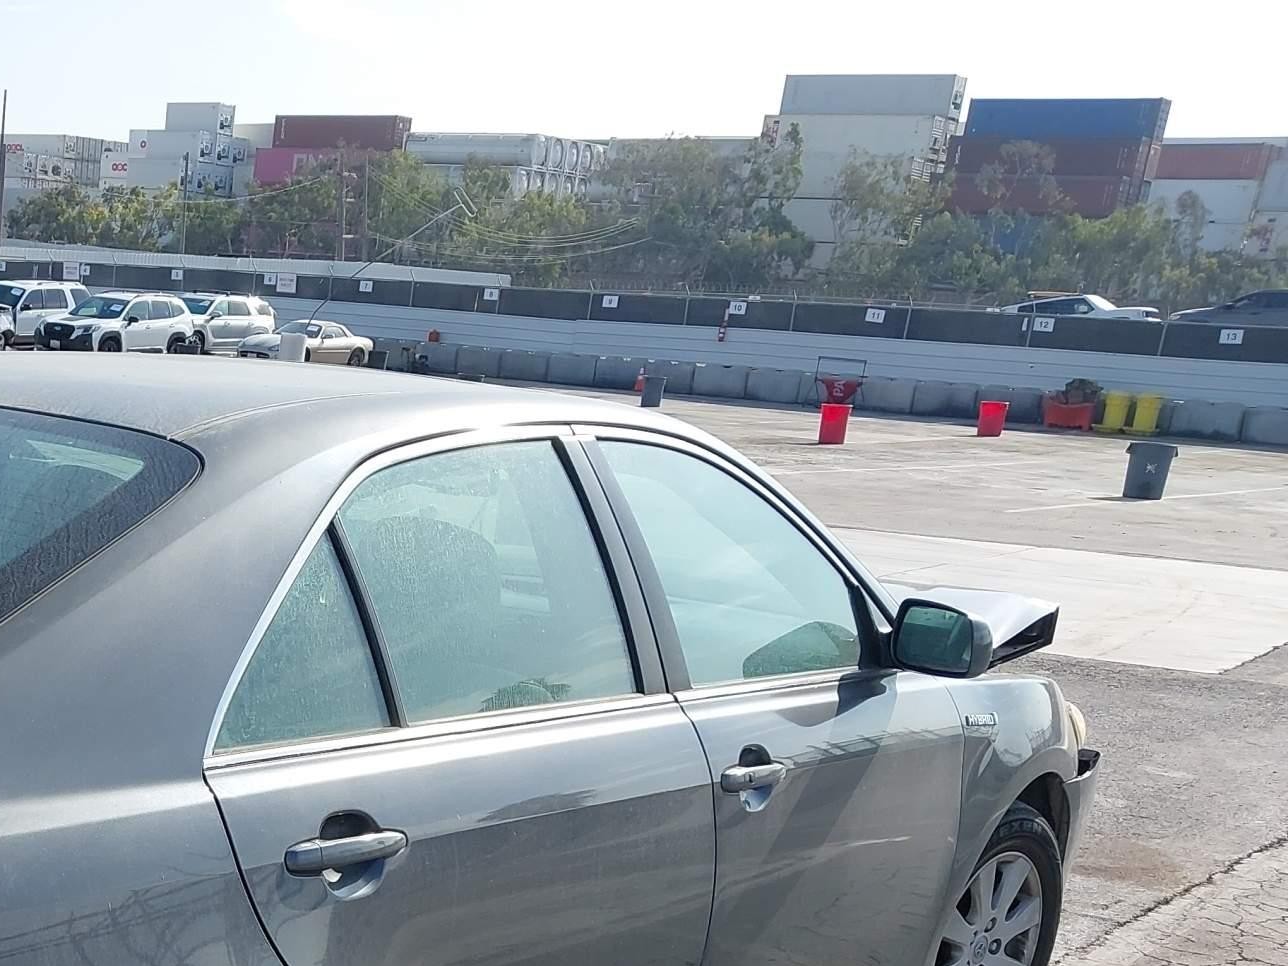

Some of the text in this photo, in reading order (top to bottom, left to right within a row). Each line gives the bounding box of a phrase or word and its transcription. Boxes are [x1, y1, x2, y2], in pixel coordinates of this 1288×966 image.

[112, 162, 127, 171] OOC
[733, 304, 742, 312] 10
[1040, 320, 1049, 328] 12
[1225, 332, 1237, 341] 13
[968, 714, 995, 726] HYBRID
[998, 820, 1042, 837] EXEN
